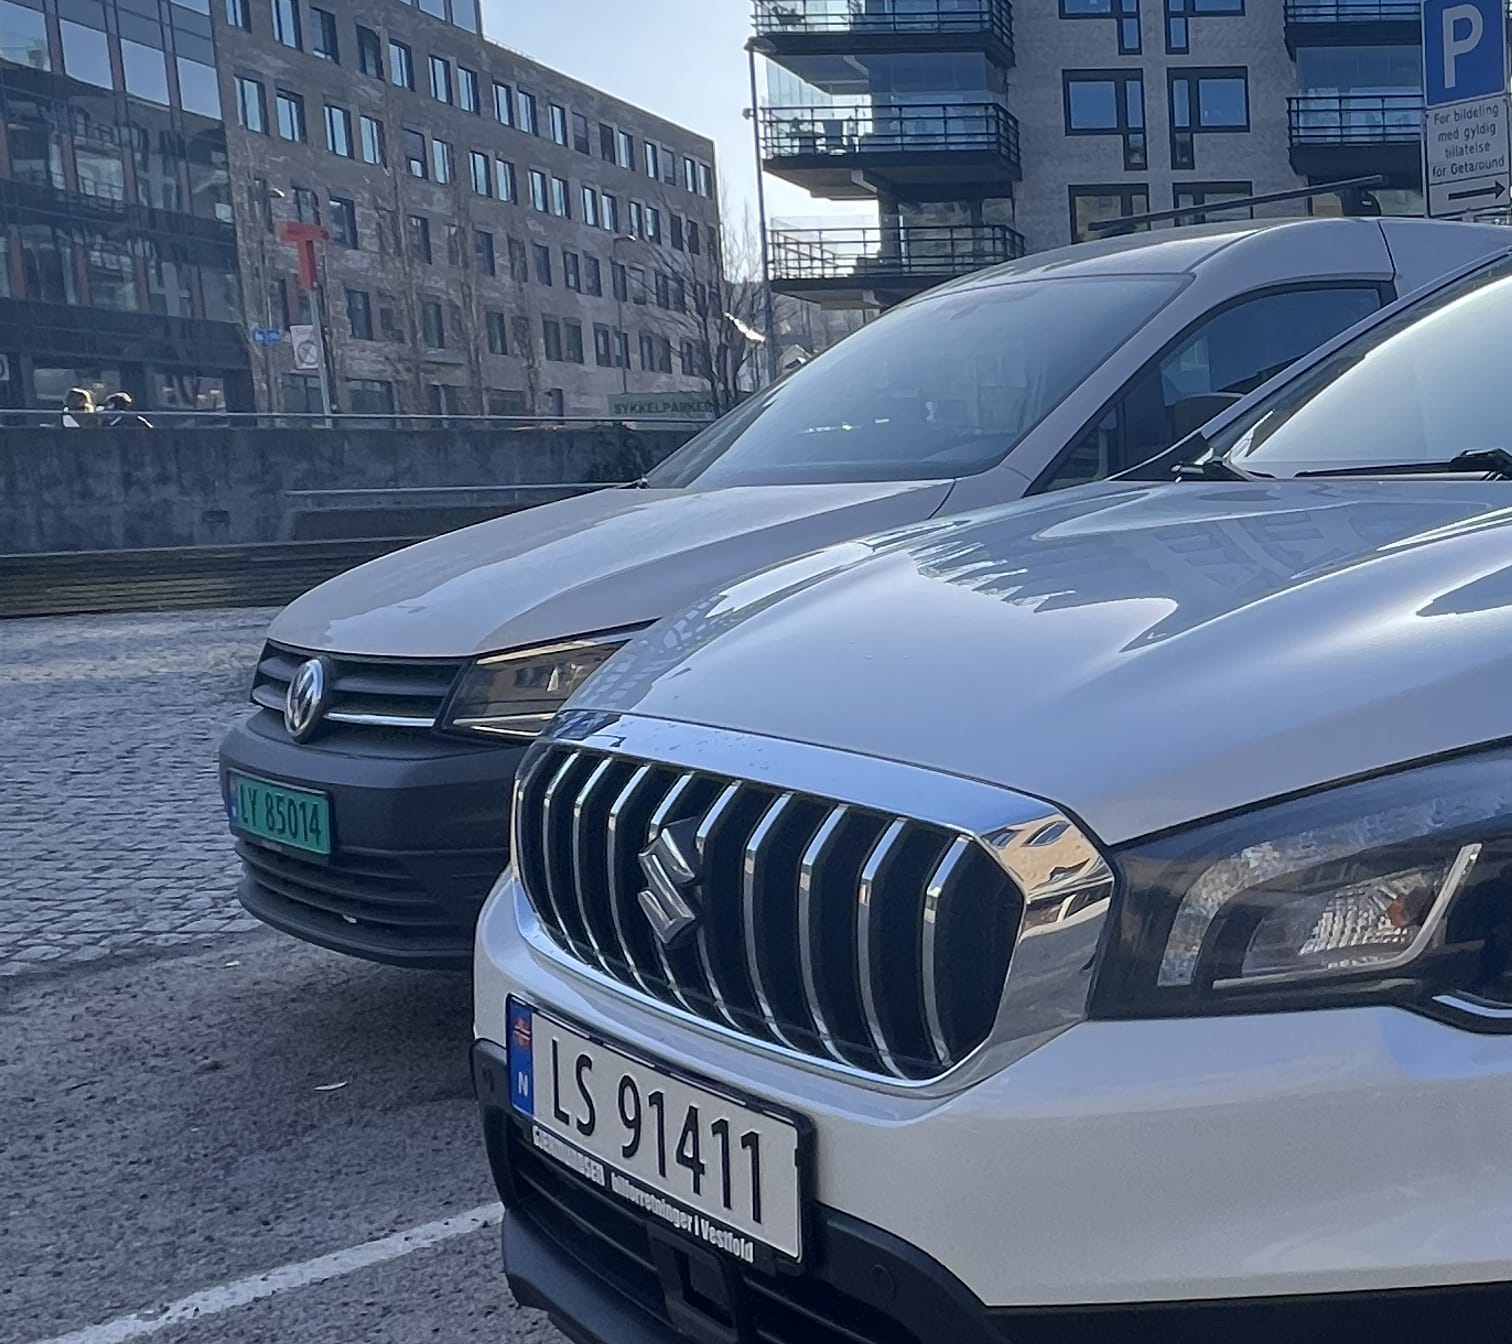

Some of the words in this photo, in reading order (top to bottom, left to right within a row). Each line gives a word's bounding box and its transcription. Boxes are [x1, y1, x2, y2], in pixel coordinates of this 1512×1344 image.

[1442, 4, 1483, 89] P
[1434, 111, 1450, 125] For
[1454, 105, 1499, 122] bildeling
[1438, 129, 1459, 142] med
[1464, 121, 1496, 140] gyldig
[1445, 142, 1491, 160] tillatelse
[1432, 164, 1446, 178] for
[1451, 157, 1505, 176] Getaround
[239, 783, 258, 827] LY
[265, 790, 321, 844] 85014
[517, 1071, 529, 1097] N
[551, 1038, 596, 1137] LS
[617, 1073, 762, 1225] 91411
